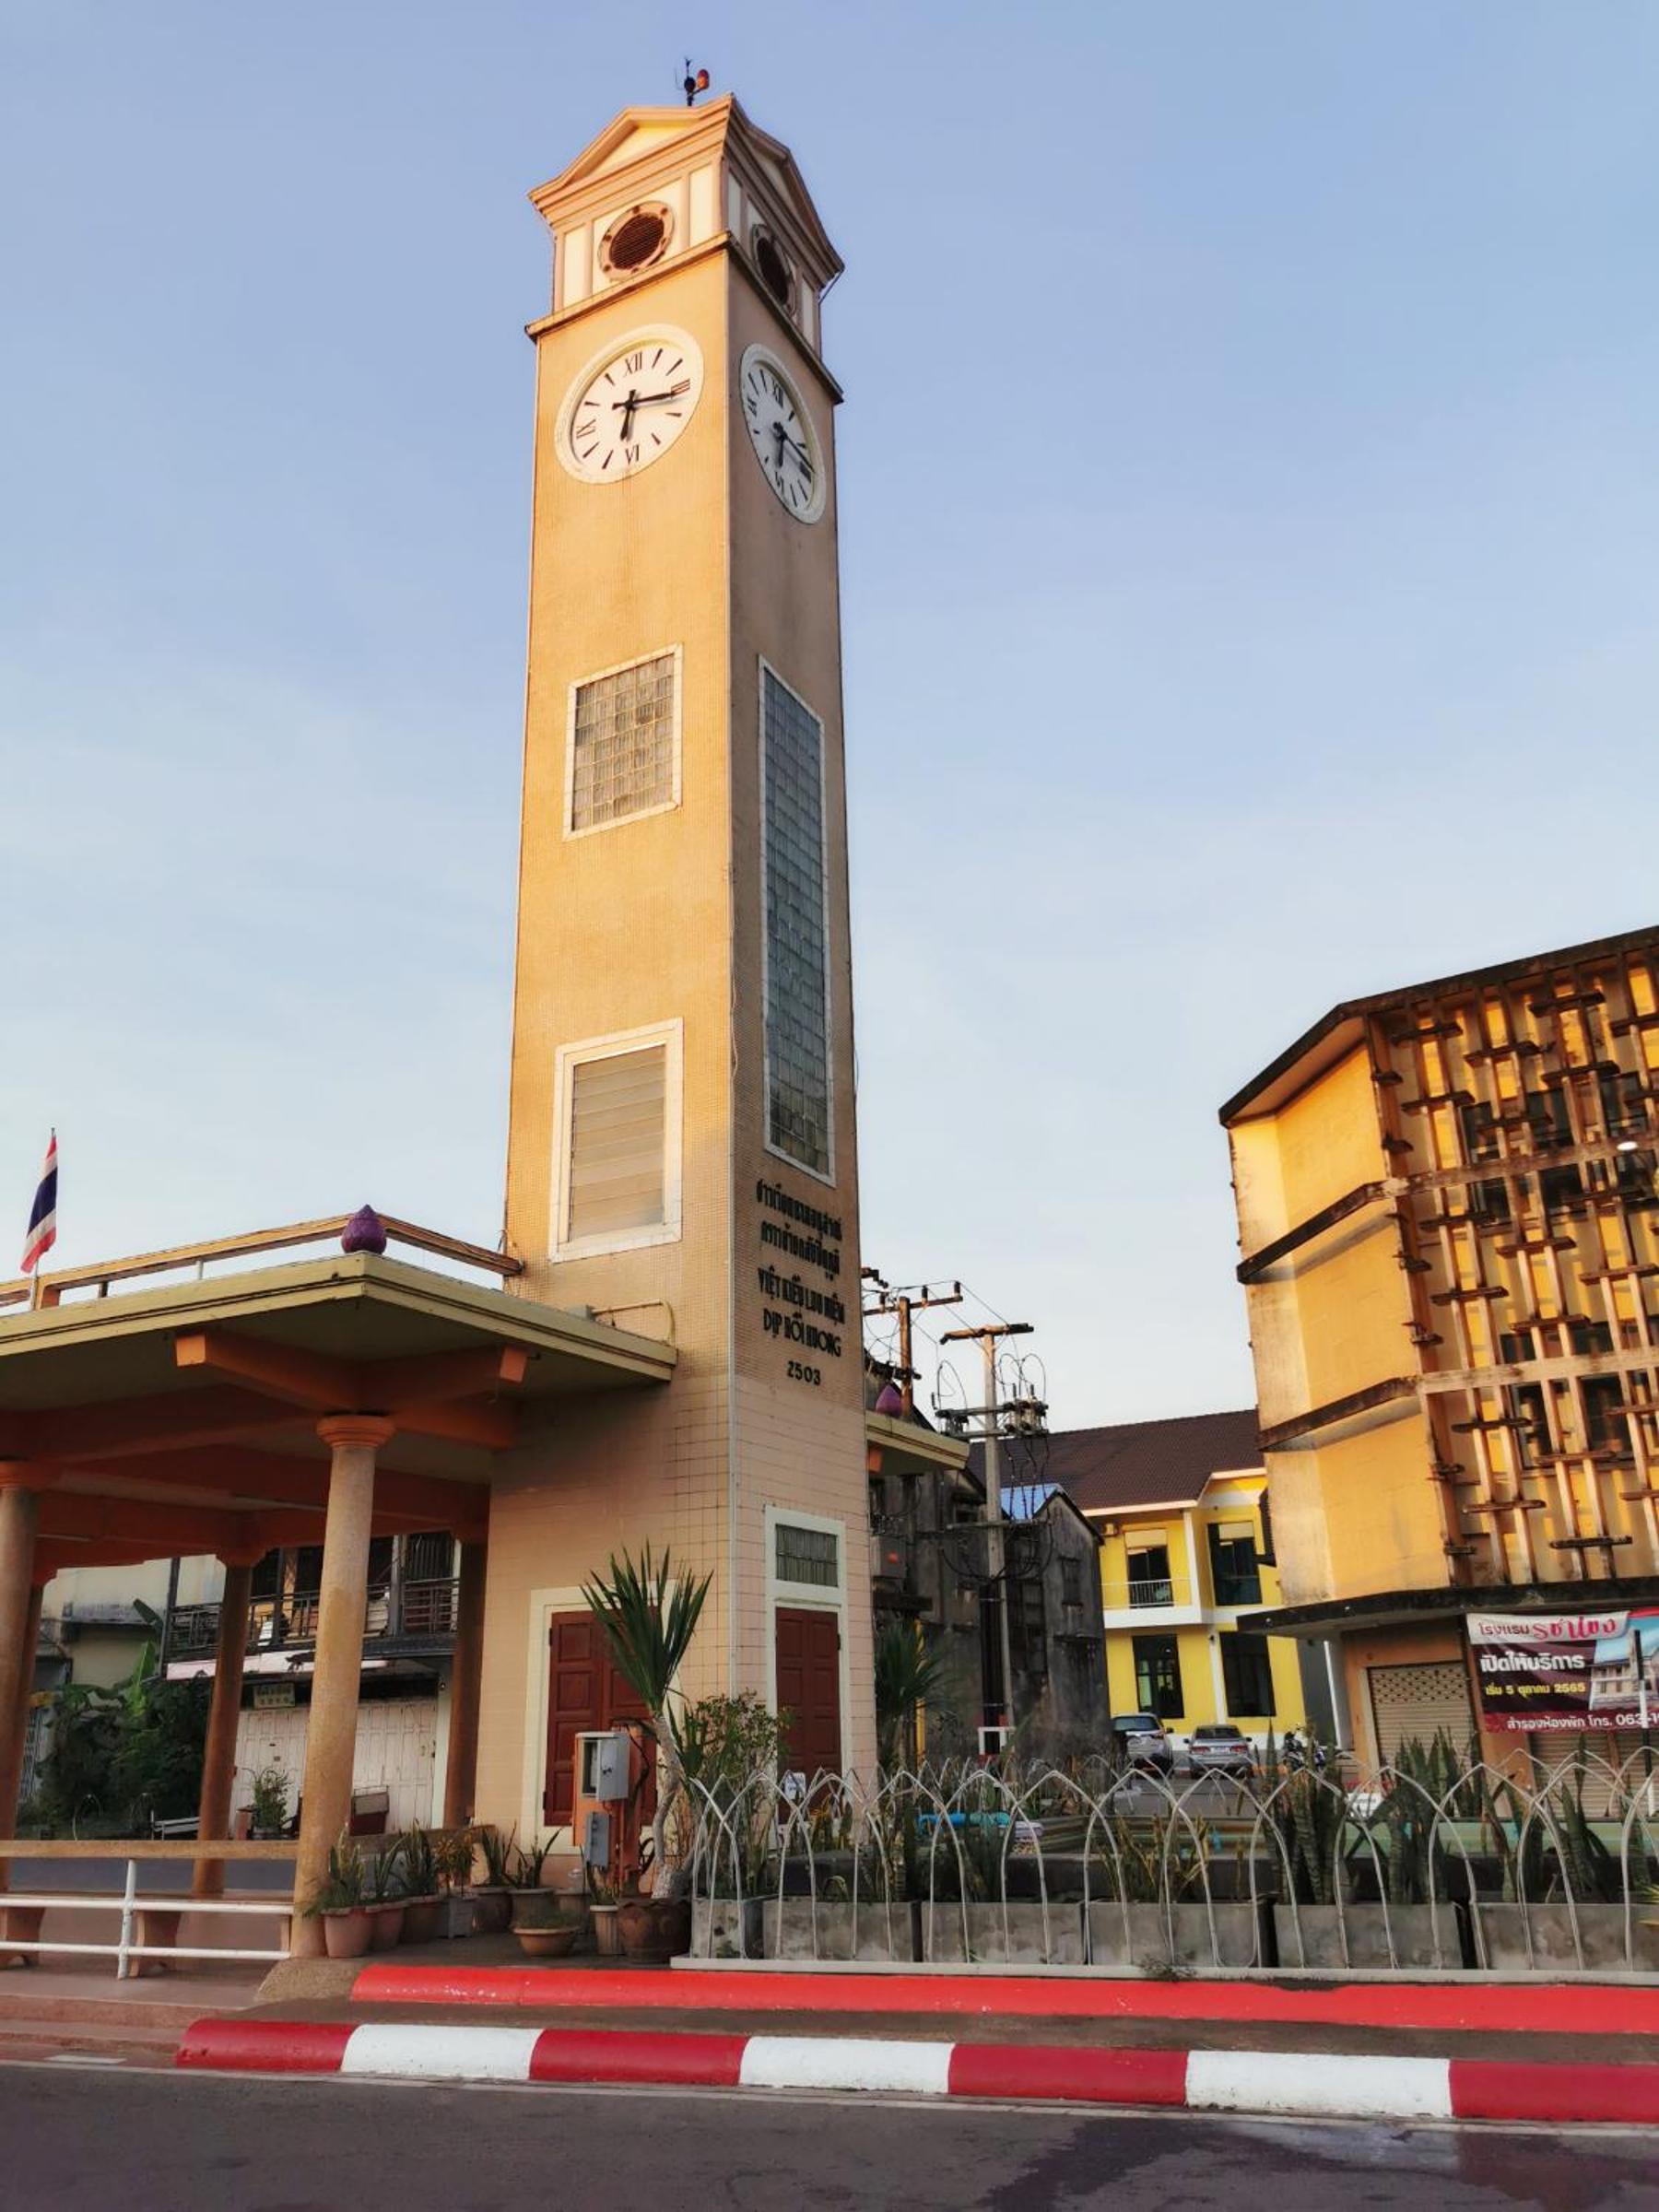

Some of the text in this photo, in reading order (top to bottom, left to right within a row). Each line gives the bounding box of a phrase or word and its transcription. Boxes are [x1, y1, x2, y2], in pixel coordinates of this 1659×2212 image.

[624, 351, 643, 377] XII
[625, 444, 640, 465] VI
[787, 1360, 821, 1386] 2503
[1479, 1619, 1529, 1636] โรงแรม
[1480, 1651, 1585, 1672] เปิดให้บริการ
[1506, 1685, 1514, 1694] 5
[1554, 1682, 1585, 1694] 2565
[1507, 1715, 1585, 1730] สำรองห้องพัก
[1588, 1713, 1613, 1726] โทร.
